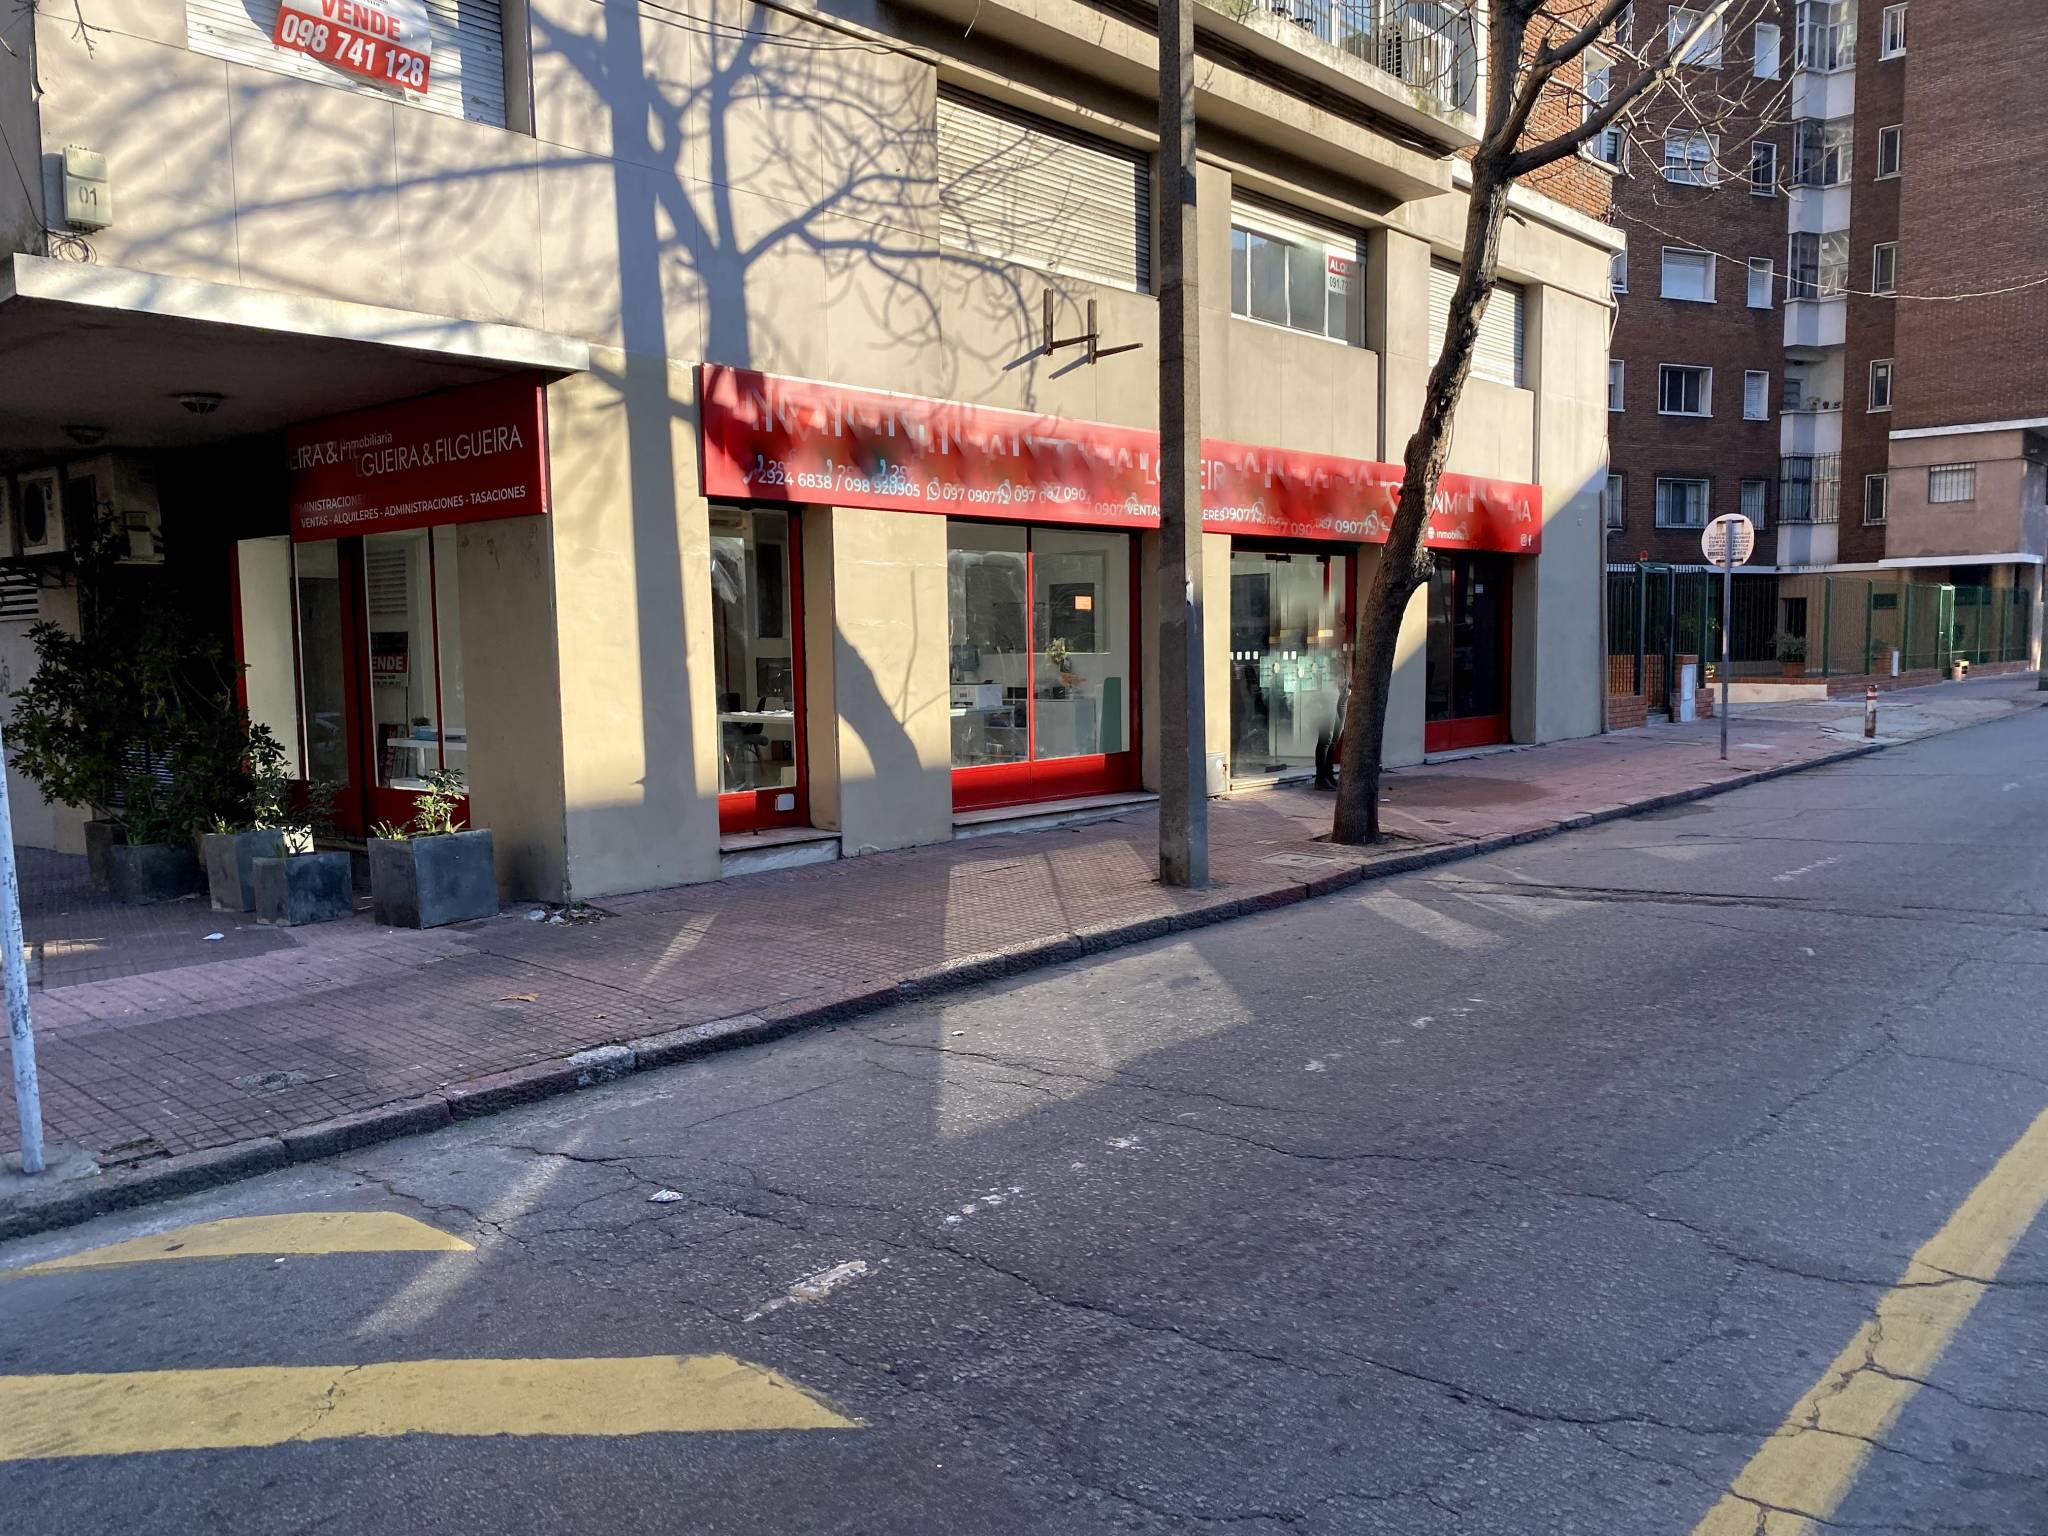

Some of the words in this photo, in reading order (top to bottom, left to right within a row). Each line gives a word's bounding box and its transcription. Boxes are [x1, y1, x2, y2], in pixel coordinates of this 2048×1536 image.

[321, 0, 400, 42] VENDE
[281, 14, 329, 53] 098
[335, 30, 376, 71] 741
[385, 49, 425, 87] 128
[79, 186, 97, 206] 01
[757, 469, 794, 486] 2924
[797, 473, 832, 489] 6838
[844, 478, 871, 493] 098
[301, 516, 328, 528] VENTAS
[333, 508, 379, 524] ALQUILERES
[384, 495, 464, 517] ADMINISTRACIONES
[470, 485, 526, 505] TASACIONES
